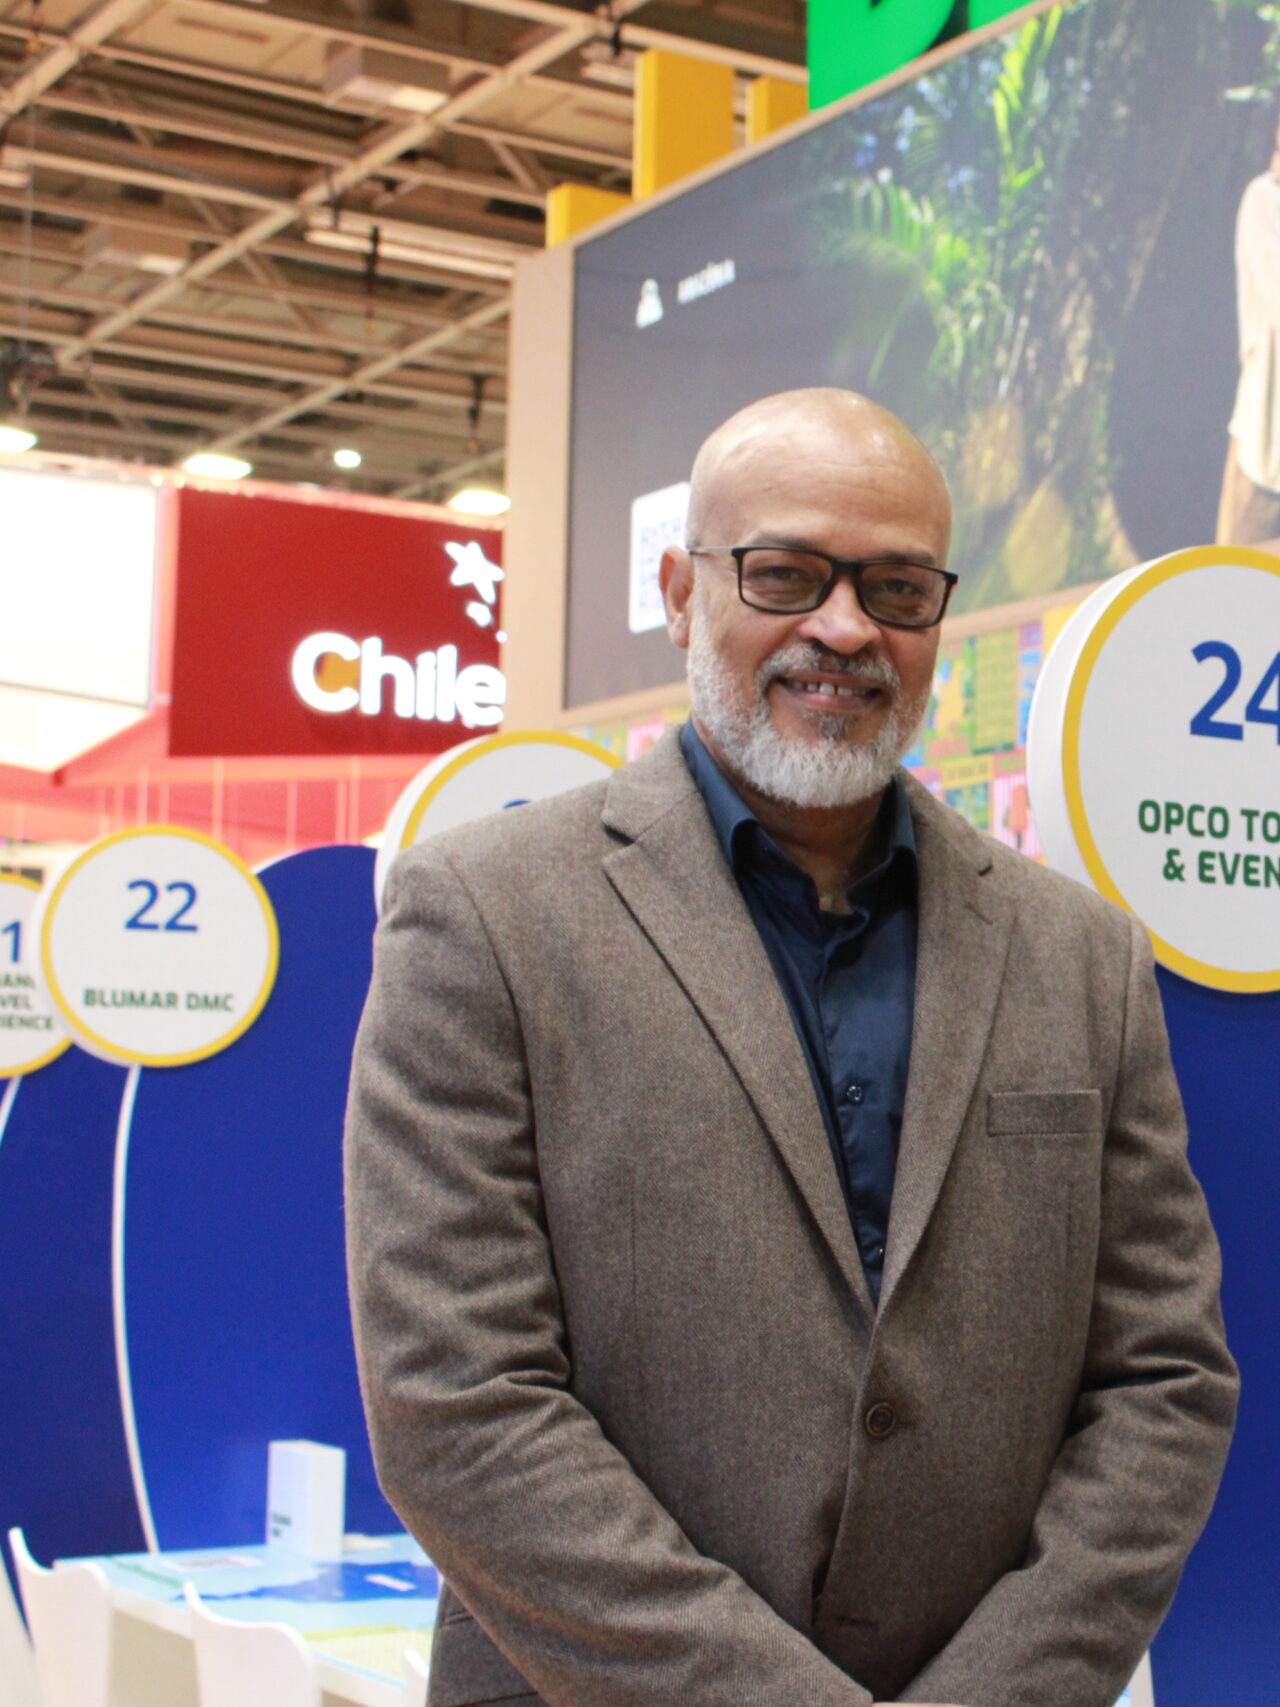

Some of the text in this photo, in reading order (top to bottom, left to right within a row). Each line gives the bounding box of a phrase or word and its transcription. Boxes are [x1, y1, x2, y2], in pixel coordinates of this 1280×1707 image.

[291, 631, 507, 727] Chile
[1138, 799, 1230, 840] OPCO
[1162, 847, 1186, 883] &
[125, 879, 198, 932] 22
[83, 988, 234, 1012] BLUMAR DMC
